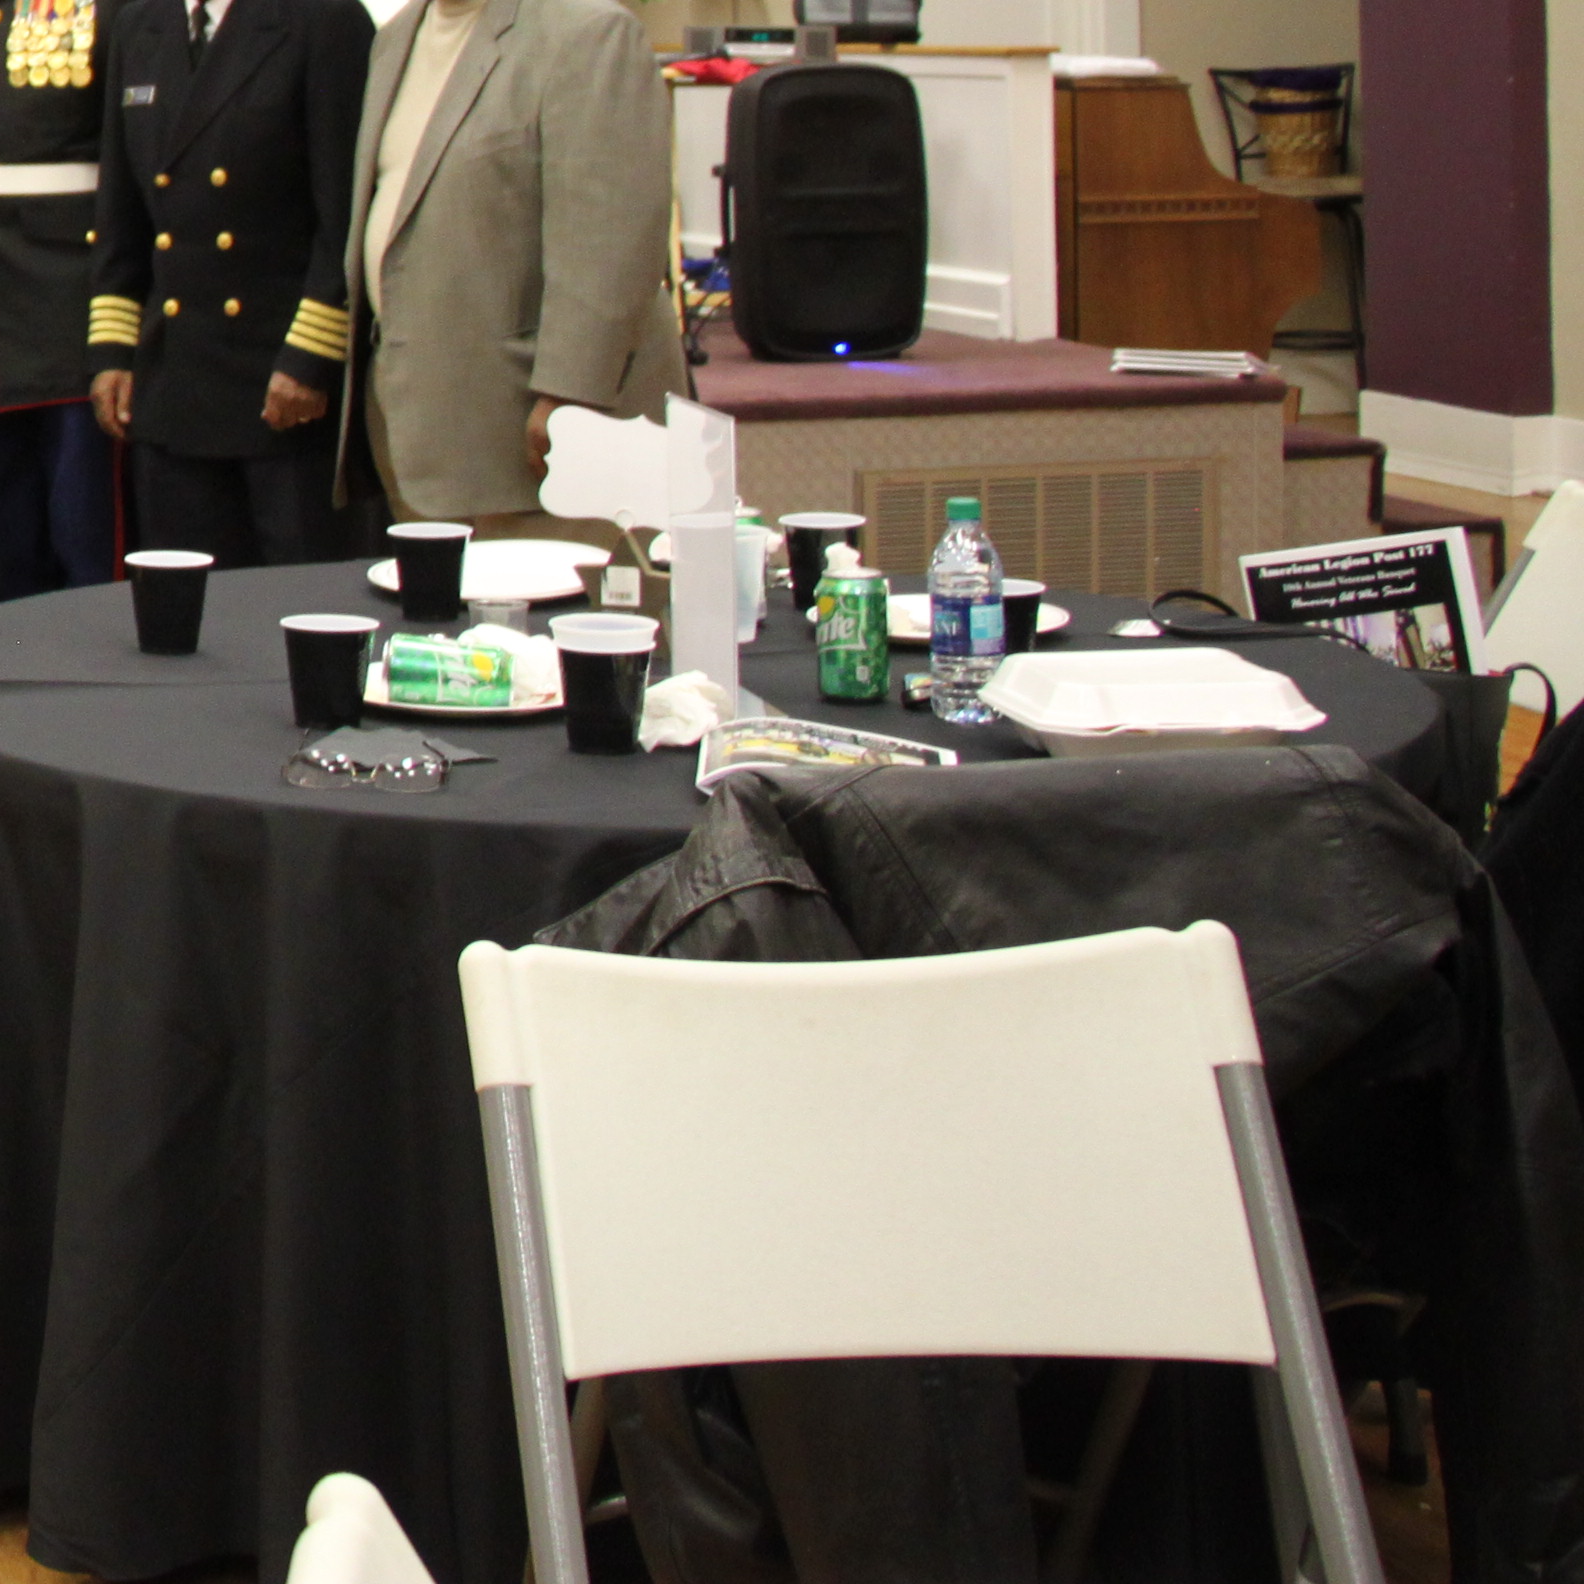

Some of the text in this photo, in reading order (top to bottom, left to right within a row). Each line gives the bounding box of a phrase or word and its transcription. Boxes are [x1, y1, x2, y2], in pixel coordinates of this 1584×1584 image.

[1258, 544, 1434, 578] American Legion Post 177
[1304, 577, 1336, 590] Annual
[1337, 573, 1376, 586] Veterans
[1377, 567, 1416, 580] Banquet
[1290, 582, 1416, 610] Honoring All Who Served
